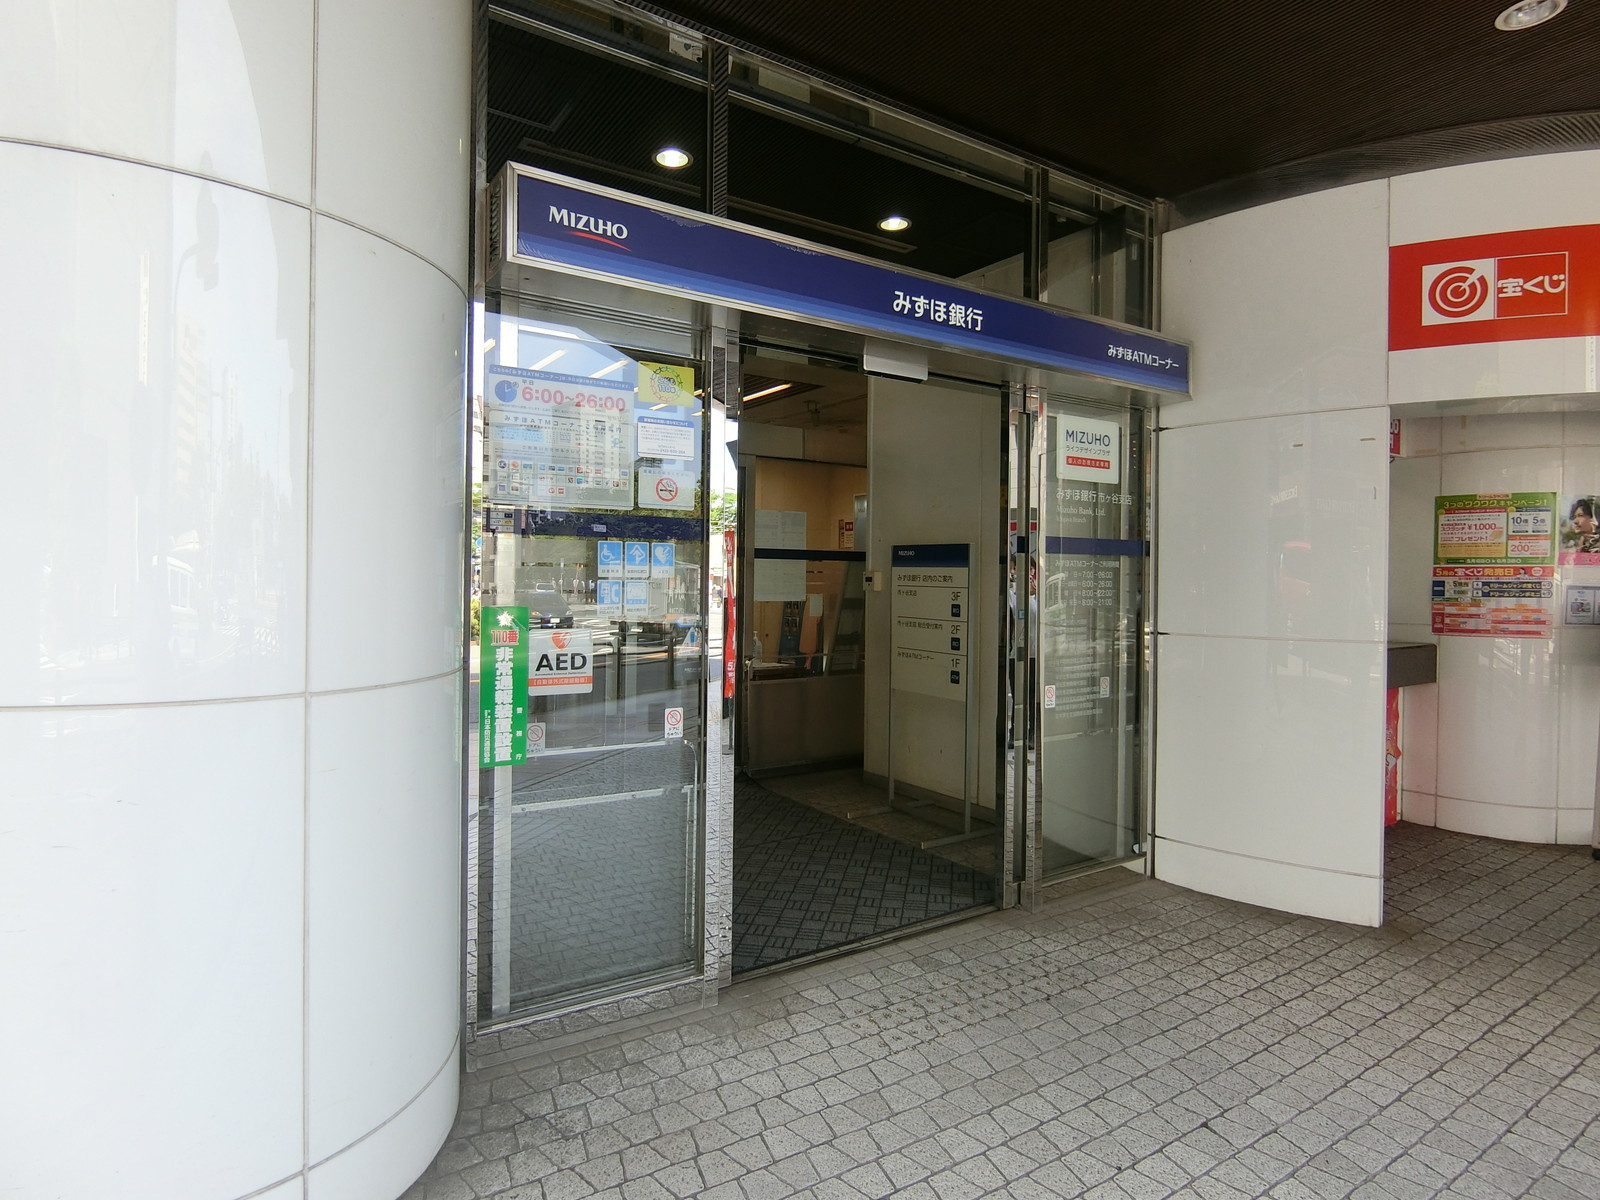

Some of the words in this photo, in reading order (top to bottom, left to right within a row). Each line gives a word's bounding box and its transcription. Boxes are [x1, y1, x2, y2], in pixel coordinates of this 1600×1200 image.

[548, 205, 629, 240] MIZUHO
[1497, 273, 1566, 298] 宝くじ
[892, 290, 984, 331] みずほ銀行
[1107, 344, 1180, 369] みずほATMコーナー
[1065, 429, 1111, 447] MIZUHO
[1056, 488, 1097, 502] みずほ銀行
[1056, 505, 1078, 513] Mizuho
[951, 591, 961, 601] 3F
[491, 629, 519, 644] 110番
[950, 624, 961, 635] 2F
[535, 652, 588, 672] AED
[951, 658, 961, 668] 1F
